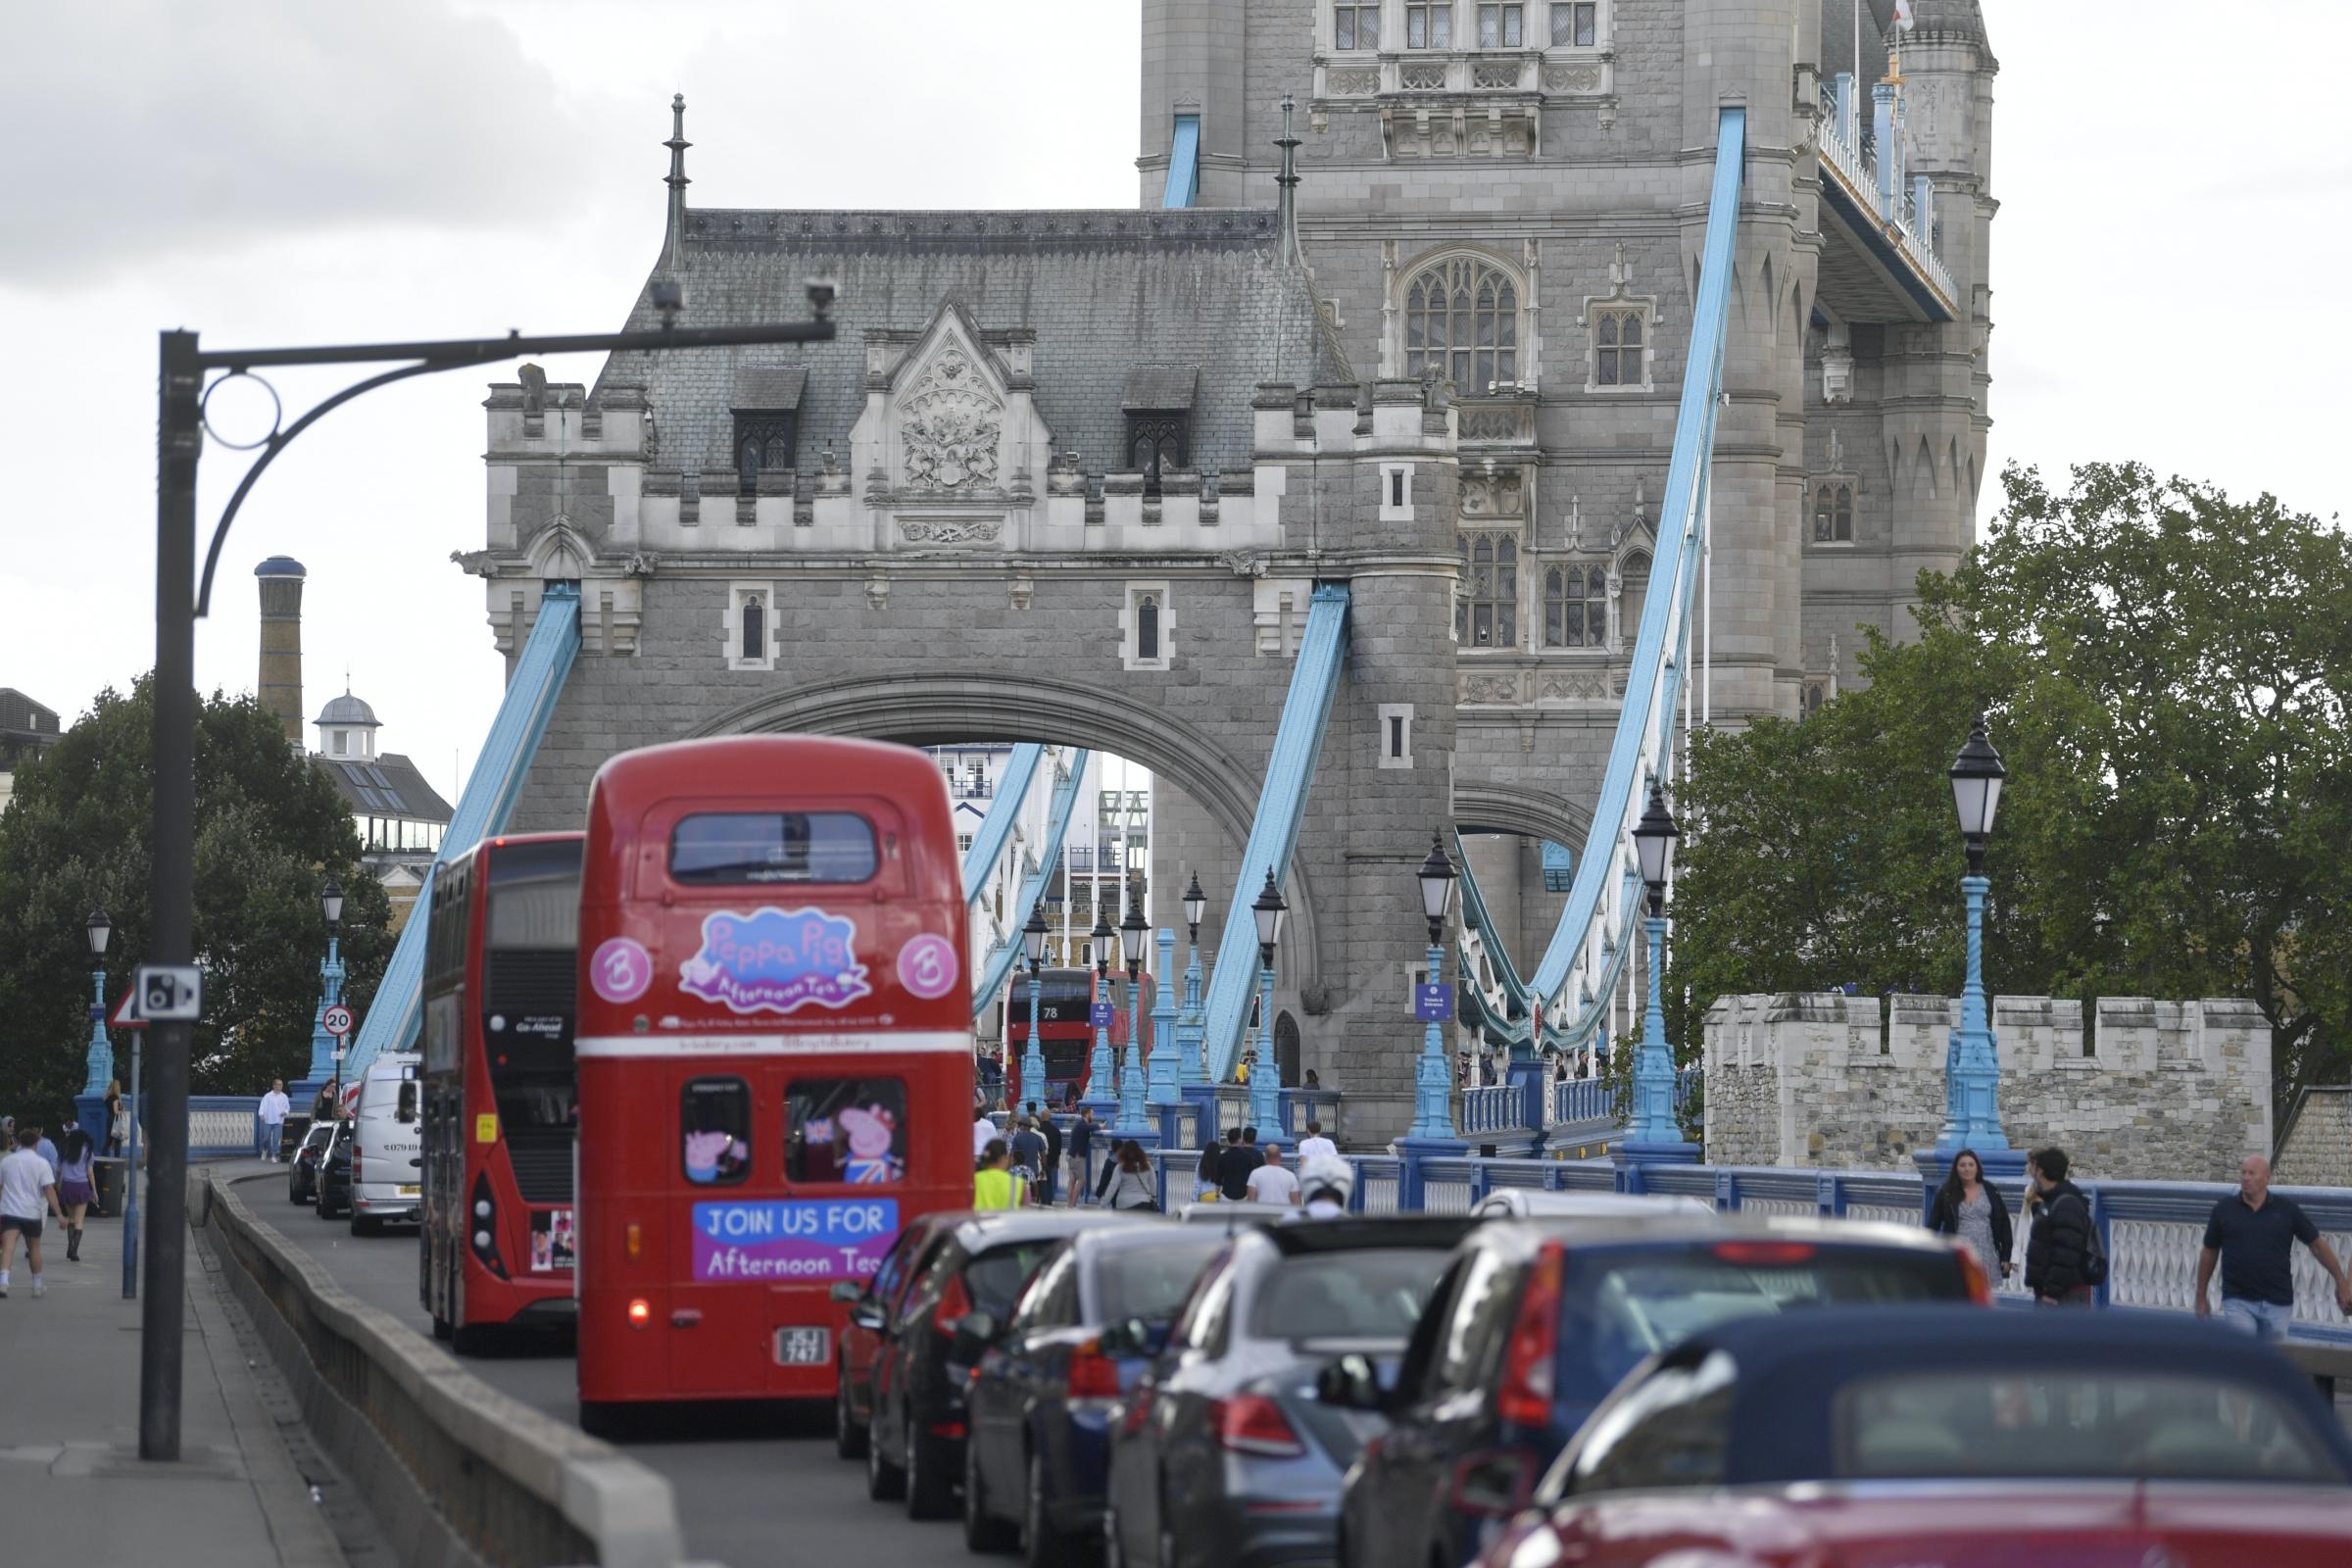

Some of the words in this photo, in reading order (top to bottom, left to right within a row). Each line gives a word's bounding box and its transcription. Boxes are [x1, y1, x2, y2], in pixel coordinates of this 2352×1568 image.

[711, 920, 796, 972] Peppa
[802, 920, 846, 967] Pig
[717, 977, 804, 1003] Afternoon
[807, 978, 837, 996] Tea
[327, 1013, 349, 1027] 20
[1044, 1007, 1057, 1019] 78
[707, 1208, 773, 1237] JOIN
[782, 1207, 819, 1235] US
[826, 1204, 885, 1234] FOR
[707, 1247, 831, 1276] Afternoon
[787, 1348, 817, 1362] 747
